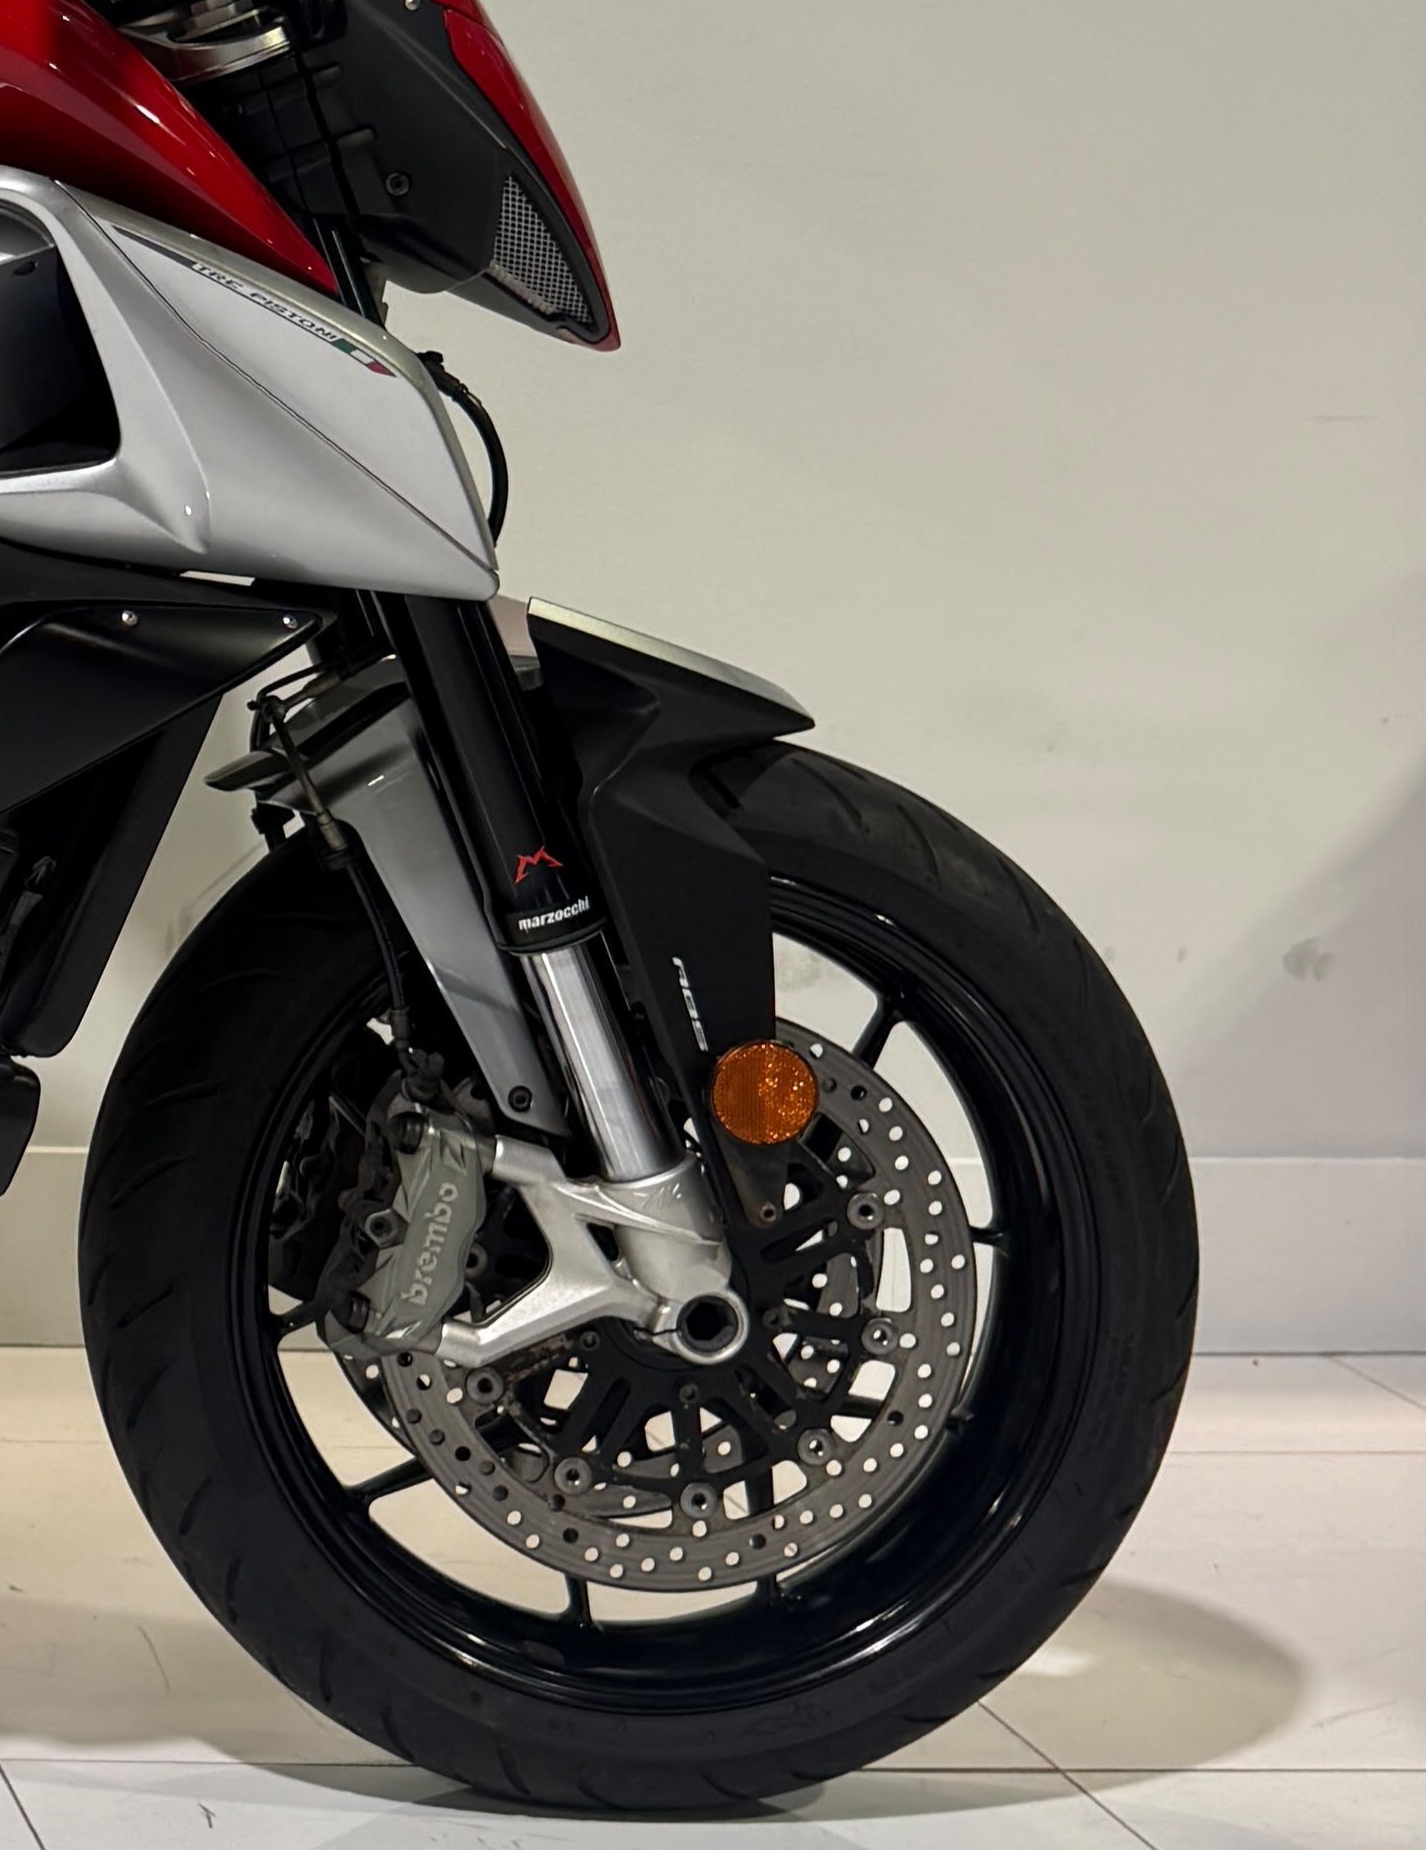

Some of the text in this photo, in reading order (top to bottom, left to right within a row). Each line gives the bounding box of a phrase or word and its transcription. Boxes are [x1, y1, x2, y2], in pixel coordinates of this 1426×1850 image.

[197, 263, 338, 340] TRE PISTONI
[518, 895, 591, 933] marzocchi
[399, 1182, 459, 1306] brembo
